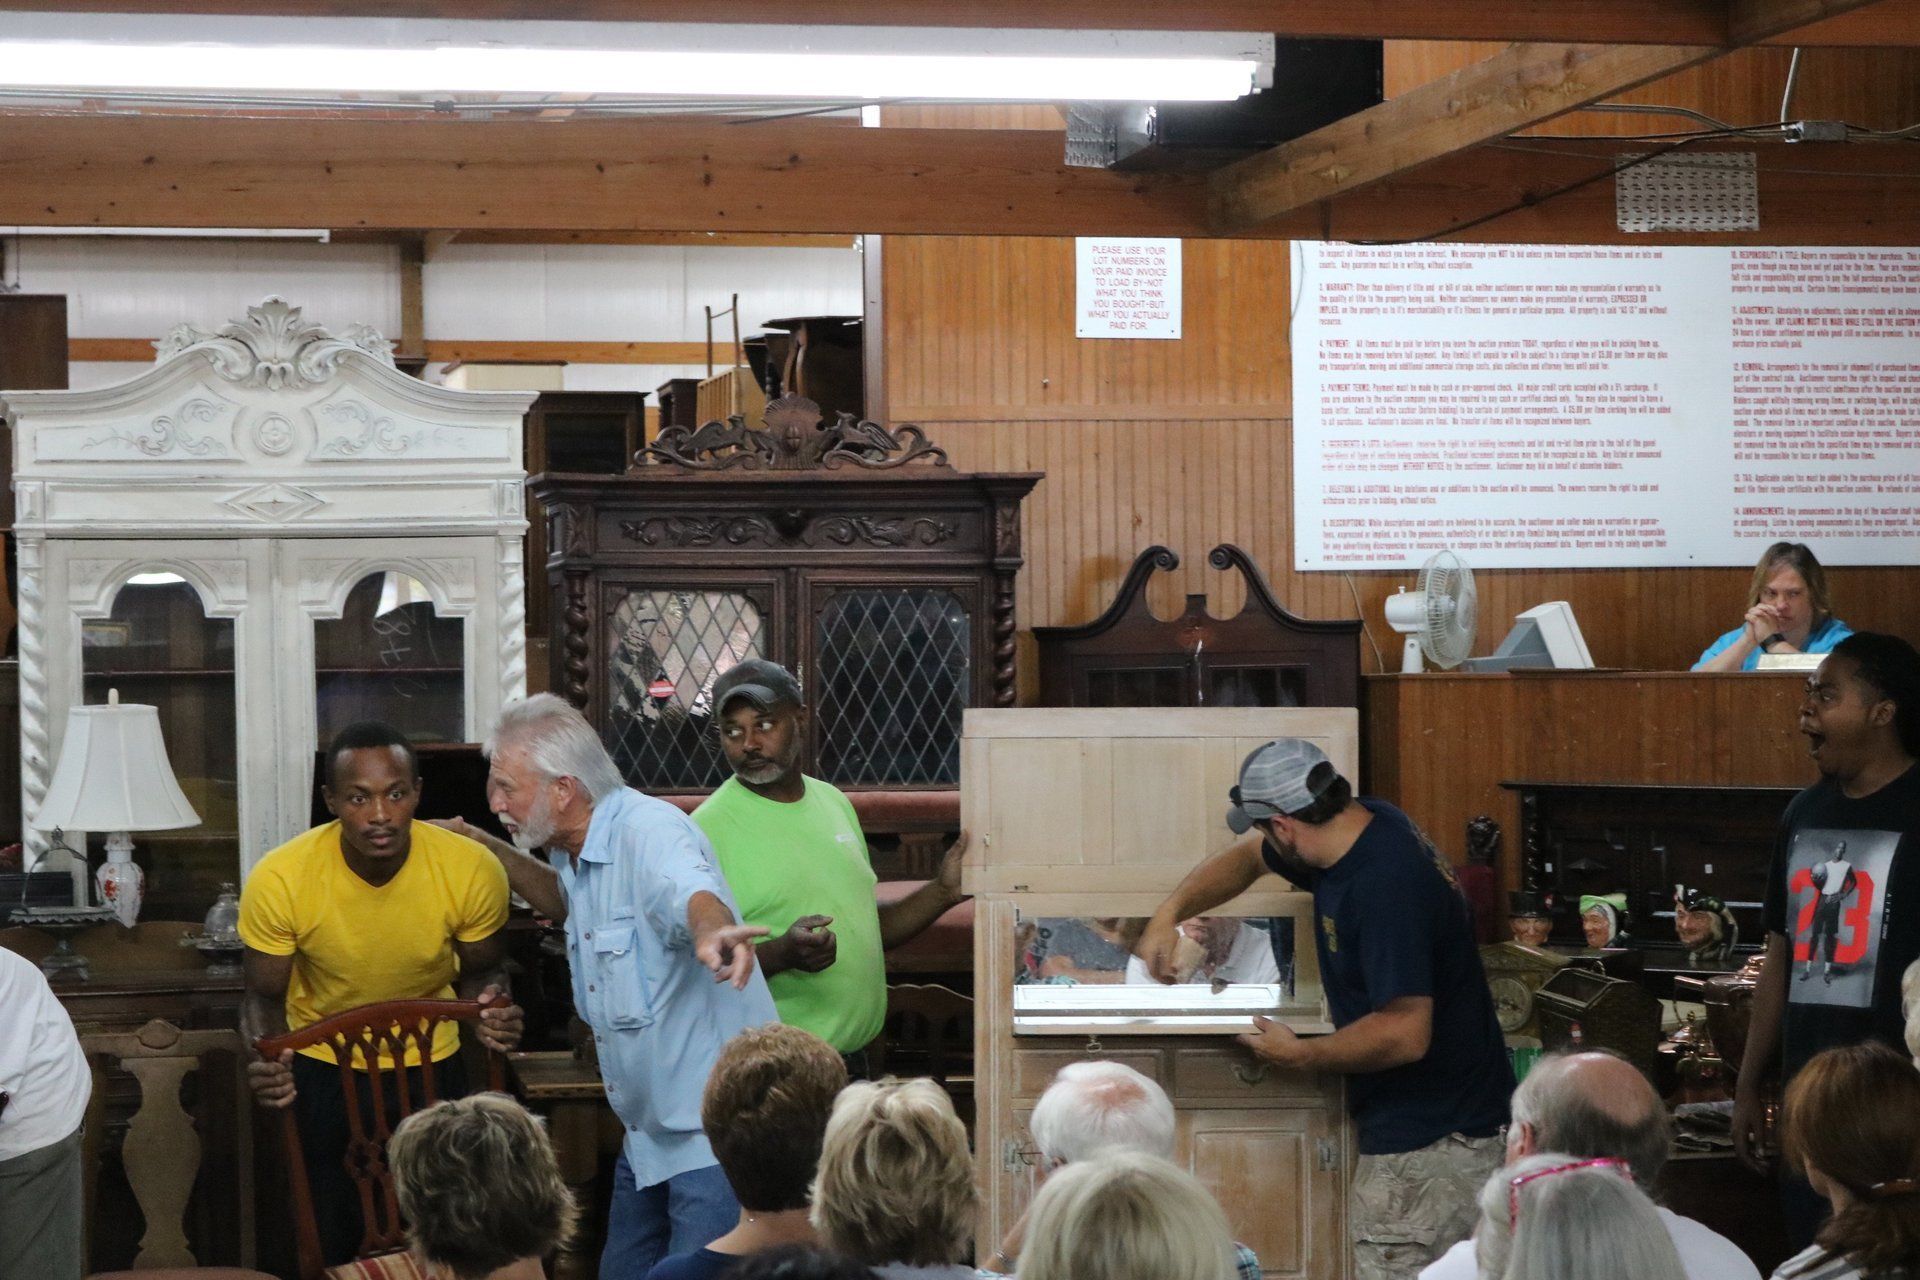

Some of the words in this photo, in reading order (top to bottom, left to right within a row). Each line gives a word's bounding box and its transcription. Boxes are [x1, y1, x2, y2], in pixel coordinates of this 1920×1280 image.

[1092, 246, 1121, 254] PLEASE
[1125, 246, 1141, 254] USE
[1146, 246, 1165, 254] YOUR
[1094, 257, 1107, 265] LOT
[1111, 257, 1150, 265] NUMBERS
[1154, 257, 1164, 265] ON
[1092, 268, 1113, 276] YOUR
[1116, 268, 1133, 276] PAID
[1136, 268, 1167, 276] INVOICE
[1096, 278, 1106, 286] TO
[1109, 278, 1130, 286] LOAD
[1096, 289, 1117, 297] WHAT
[1121, 289, 1137, 297] YOU
[1140, 289, 1162, 297] THINK
[1094, 300, 1110, 308] YOU
[1088, 311, 1108, 319] WHAT
[1114, 311, 1129, 319] YOU
[1132, 311, 1169, 319] ACTUALLY
[1110, 322, 1127, 330] PAID
[1790, 868, 1875, 964] 23
